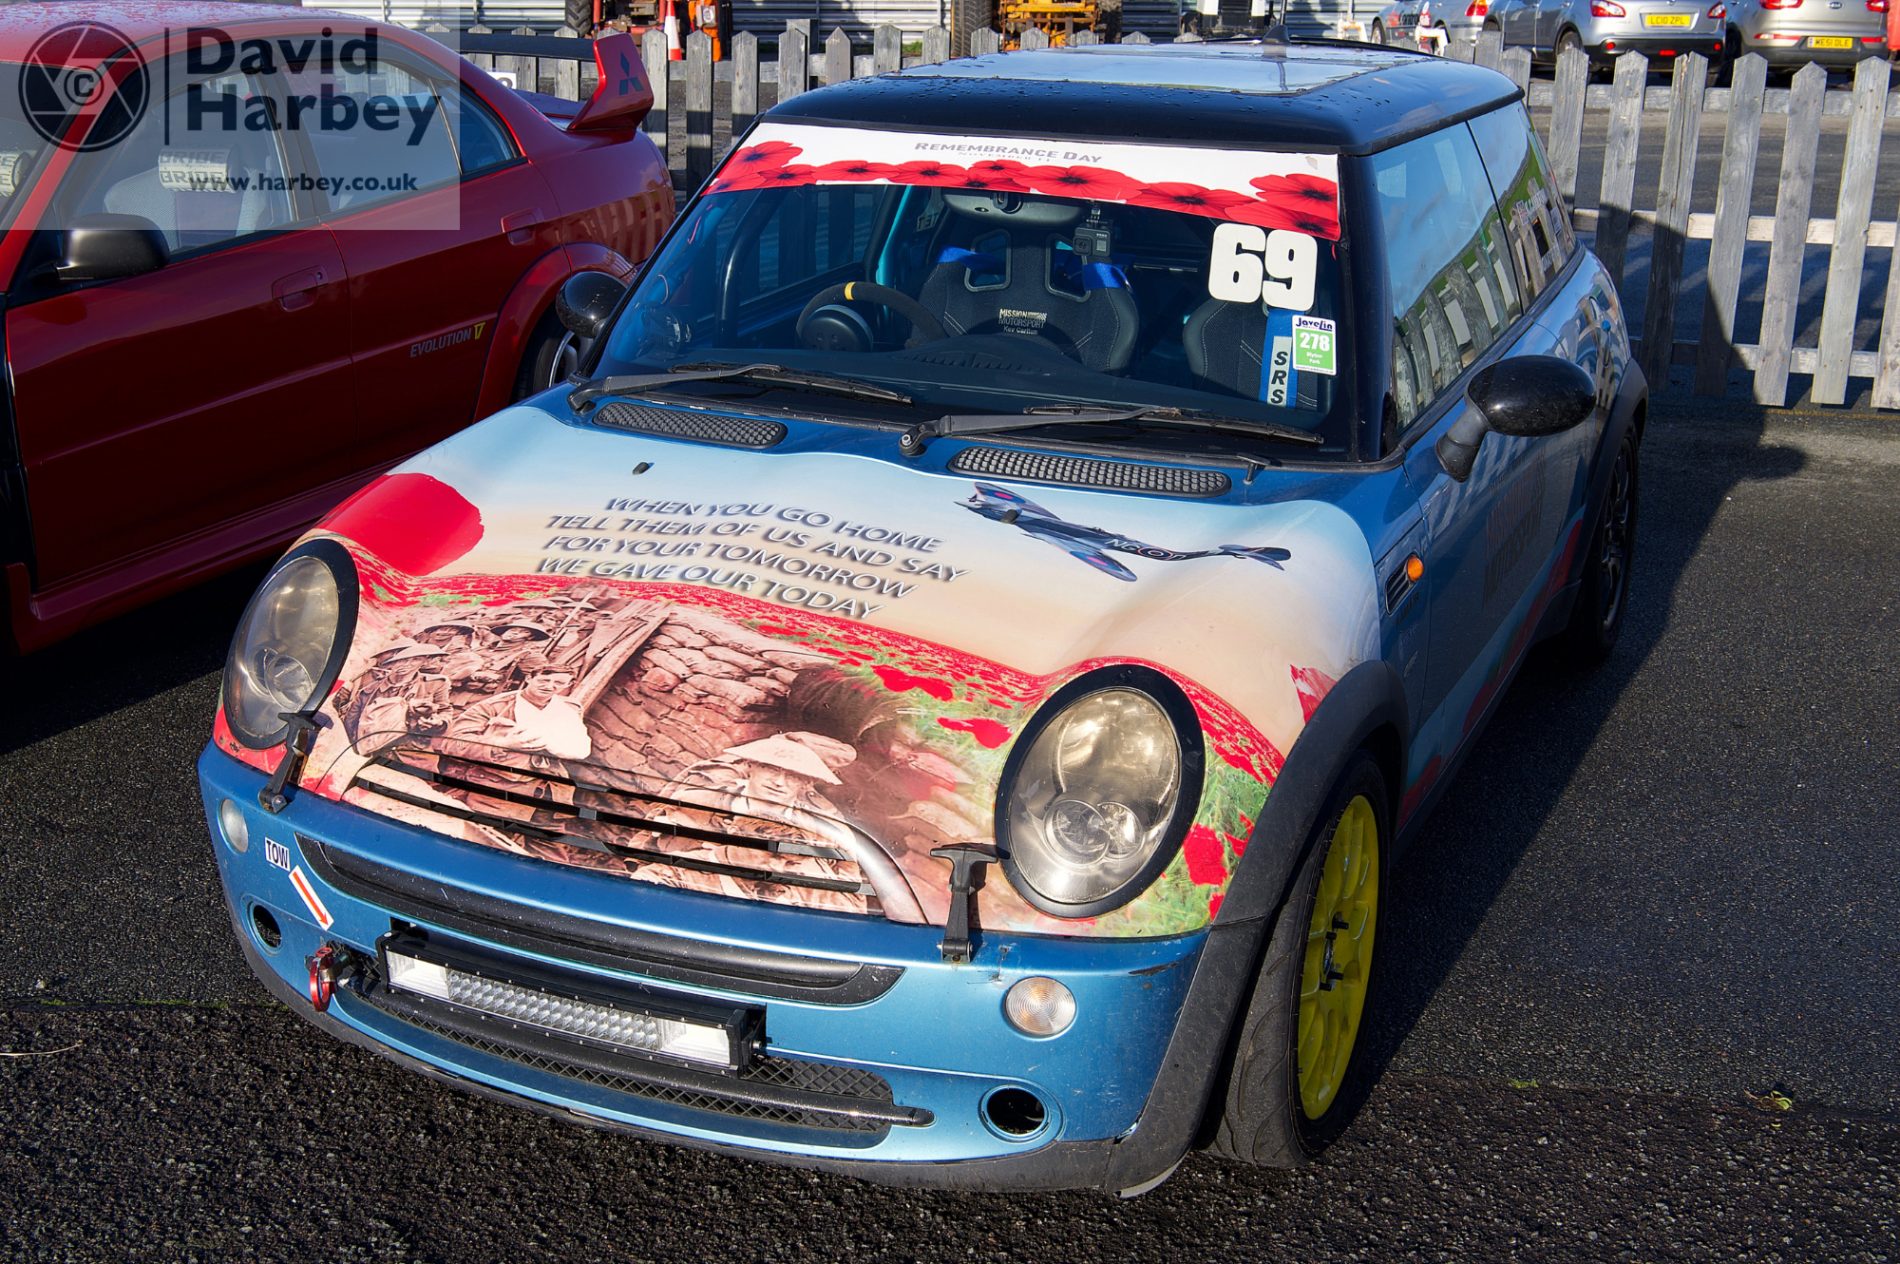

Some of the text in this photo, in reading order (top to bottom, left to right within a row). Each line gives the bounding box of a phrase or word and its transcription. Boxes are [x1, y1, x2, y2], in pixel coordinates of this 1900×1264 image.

[914, 142, 1102, 163] REMEMBRANCE DAY
[1208, 222, 1318, 312] 69
[999, 308, 1028, 319] MISSION
[410, 328, 472, 358] EVOLUTION
[1299, 331, 1331, 352] 278
[606, 497, 946, 553] WHEN YOU GO HOME
[543, 535, 920, 599] FOR YOUR TOMORROW
[546, 514, 969, 583] TELL THEM OF US AND SAY
[536, 556, 885, 620] WE GAVE OUR TODAY
[266, 839, 288, 868] TOW
